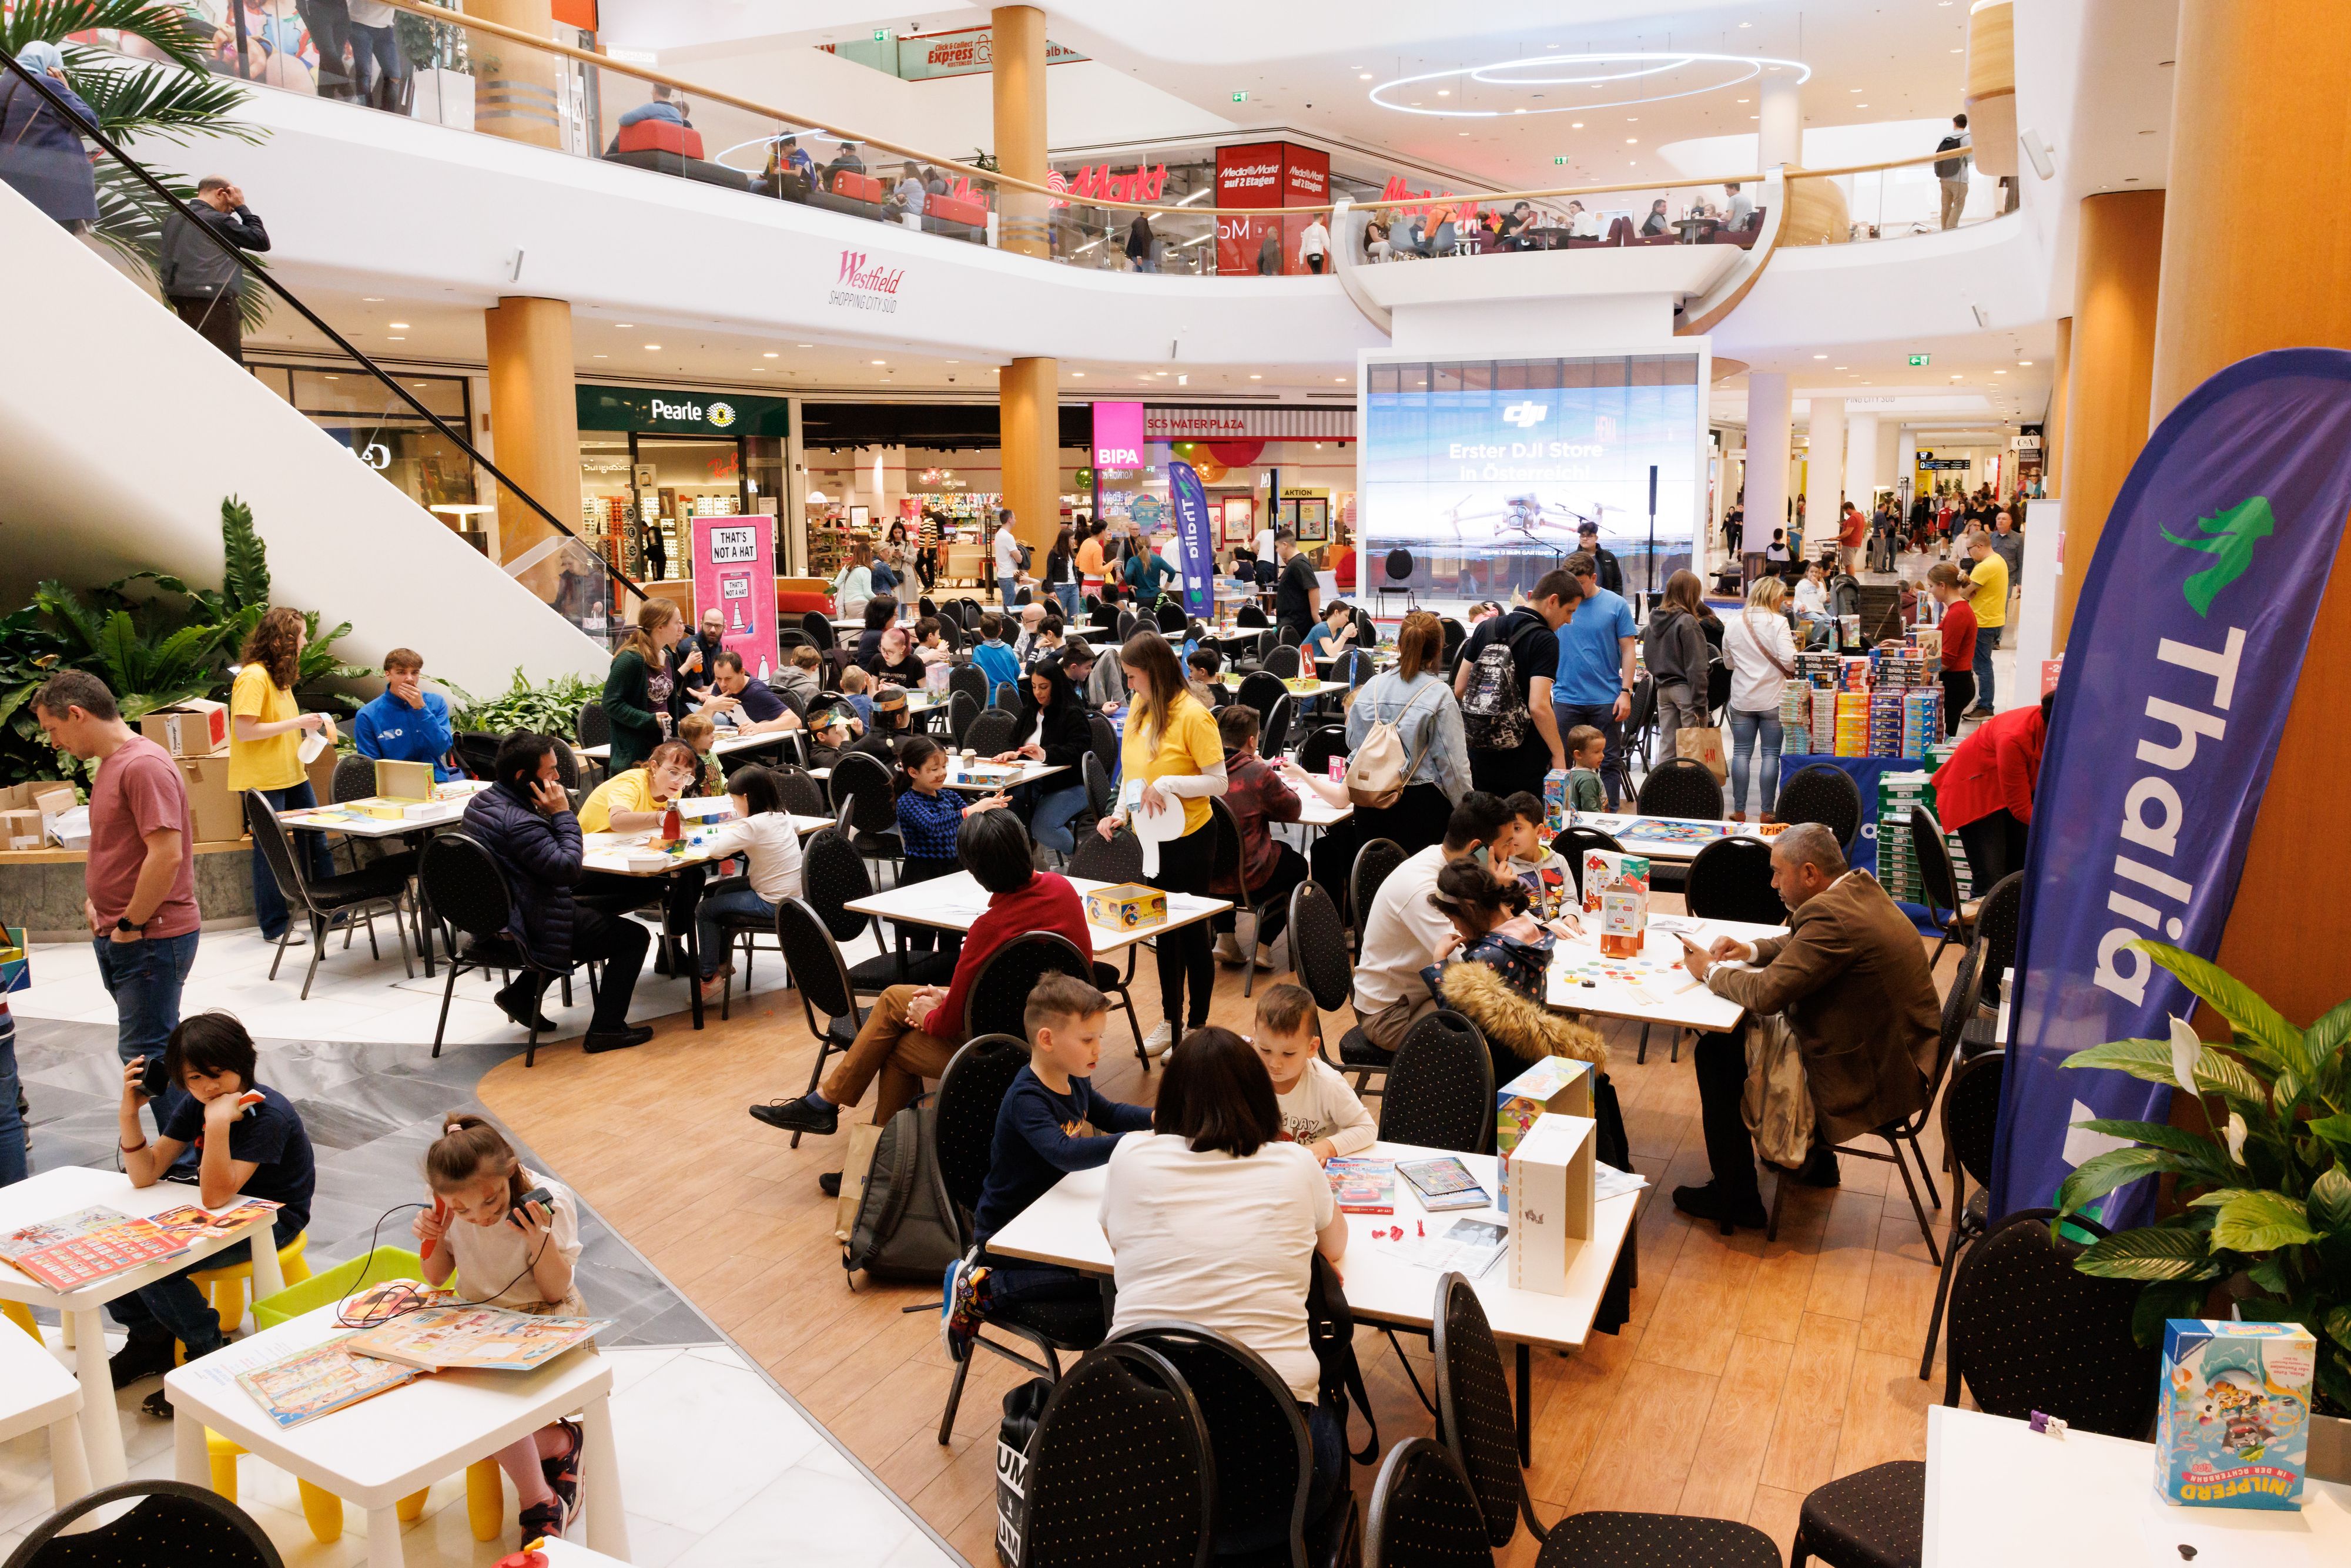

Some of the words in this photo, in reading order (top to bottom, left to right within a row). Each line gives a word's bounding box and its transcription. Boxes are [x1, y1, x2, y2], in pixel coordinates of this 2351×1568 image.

[927, 47, 973, 65] Express
[1063, 164, 1168, 203] Markt
[1224, 178, 1239, 188] auf
[1240, 178, 1245, 186] 2
[1246, 176, 1275, 187] Etagen
[1291, 178, 1301, 187] auf
[1301, 180, 1305, 188] 2
[1305, 180, 1322, 192] Etagen
[837, 250, 905, 294] Westfield
[829, 290, 866, 309] SHOPPING
[866, 296, 882, 311] CITY
[882, 297, 897, 313] SÜD
[651, 399, 702, 421] Pearle
[1147, 419, 1168, 428] SCS
[1170, 419, 1207, 429] WATER
[1210, 419, 1245, 429] PLAZA
[1099, 449, 1139, 464] BIPA
[1449, 444, 1506, 459] Erster
[1512, 443, 1542, 458] DJI
[1549, 442, 1603, 457] Store
[1461, 464, 1476, 481] in
[1483, 463, 1590, 481] Österreich!
[721, 532, 746, 544] THAT'S
[714, 547, 729, 558] NOT
[732, 547, 737, 557] A
[739, 546, 753, 557] HAT
[2094, 626, 2246, 1007] Thalia
[1290, 1117, 1319, 1131] DAY
[2190, 1467, 2249, 1482] ACHTERBAHN
[2254, 1467, 2272, 1475] DER
[2180, 1476, 2285, 1501] NILPFERD
[998, 1512, 1019, 1561] UM
